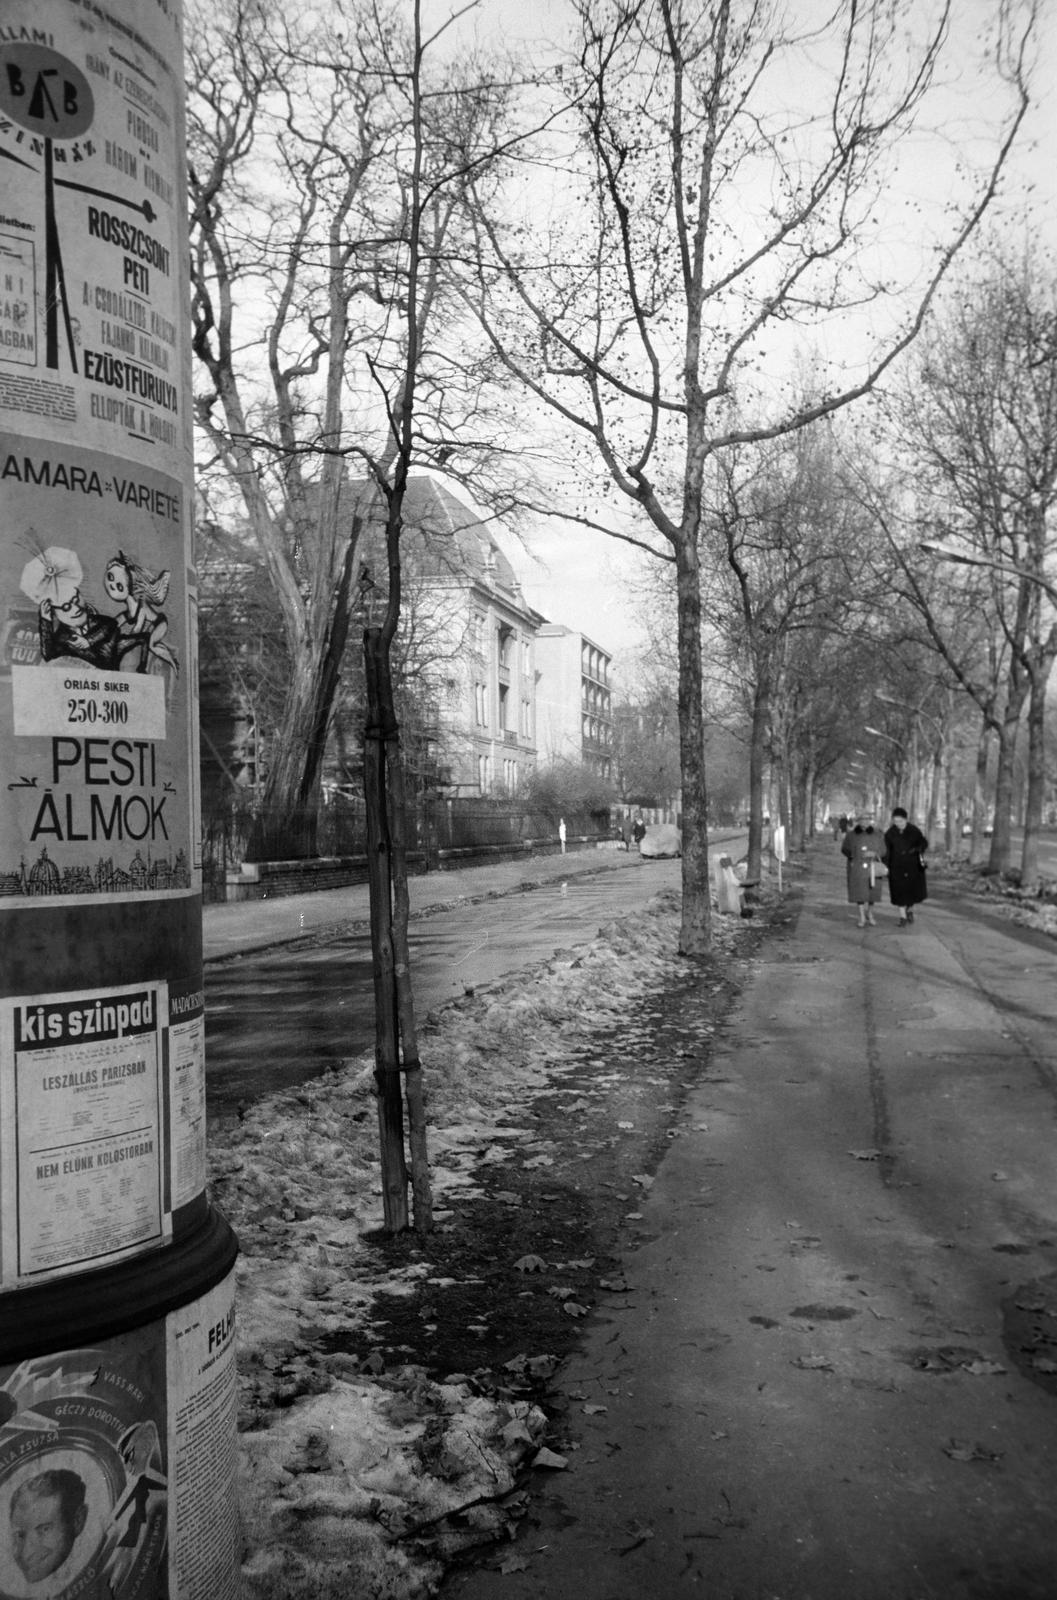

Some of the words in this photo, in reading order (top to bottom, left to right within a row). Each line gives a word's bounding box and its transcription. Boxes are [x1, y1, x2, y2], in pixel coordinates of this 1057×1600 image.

[6, 63, 78, 123] BÁB
[88, 205, 170, 277] ROSSZCSONT
[82, 281, 89, 306] A
[123, 256, 149, 295] PETI
[84, 349, 178, 415] EZÜSTFURULYA
[91, 393, 136, 430] ELLOPTÁK
[140, 409, 146, 434] A
[1, 455, 103, 498] AMARA
[113, 476, 180, 523] VARIETÉ
[64, 679, 100, 691] ÓRIÁSI
[104, 682, 130, 693] SIKER
[68, 699, 129, 724] 250-300
[52, 737, 156, 787] PESTI
[30, 789, 169, 841] ÁLMOK
[20, 1005, 63, 1043] kis
[36, 1164, 59, 1180] NEM
[97, 1141, 154, 1167] KOLOSTORBAN
[104, 1371, 125, 1389] VASS
[55, 1402, 85, 1416] GÉCZY
[20, 1431, 59, 1454] ZSUZSA
